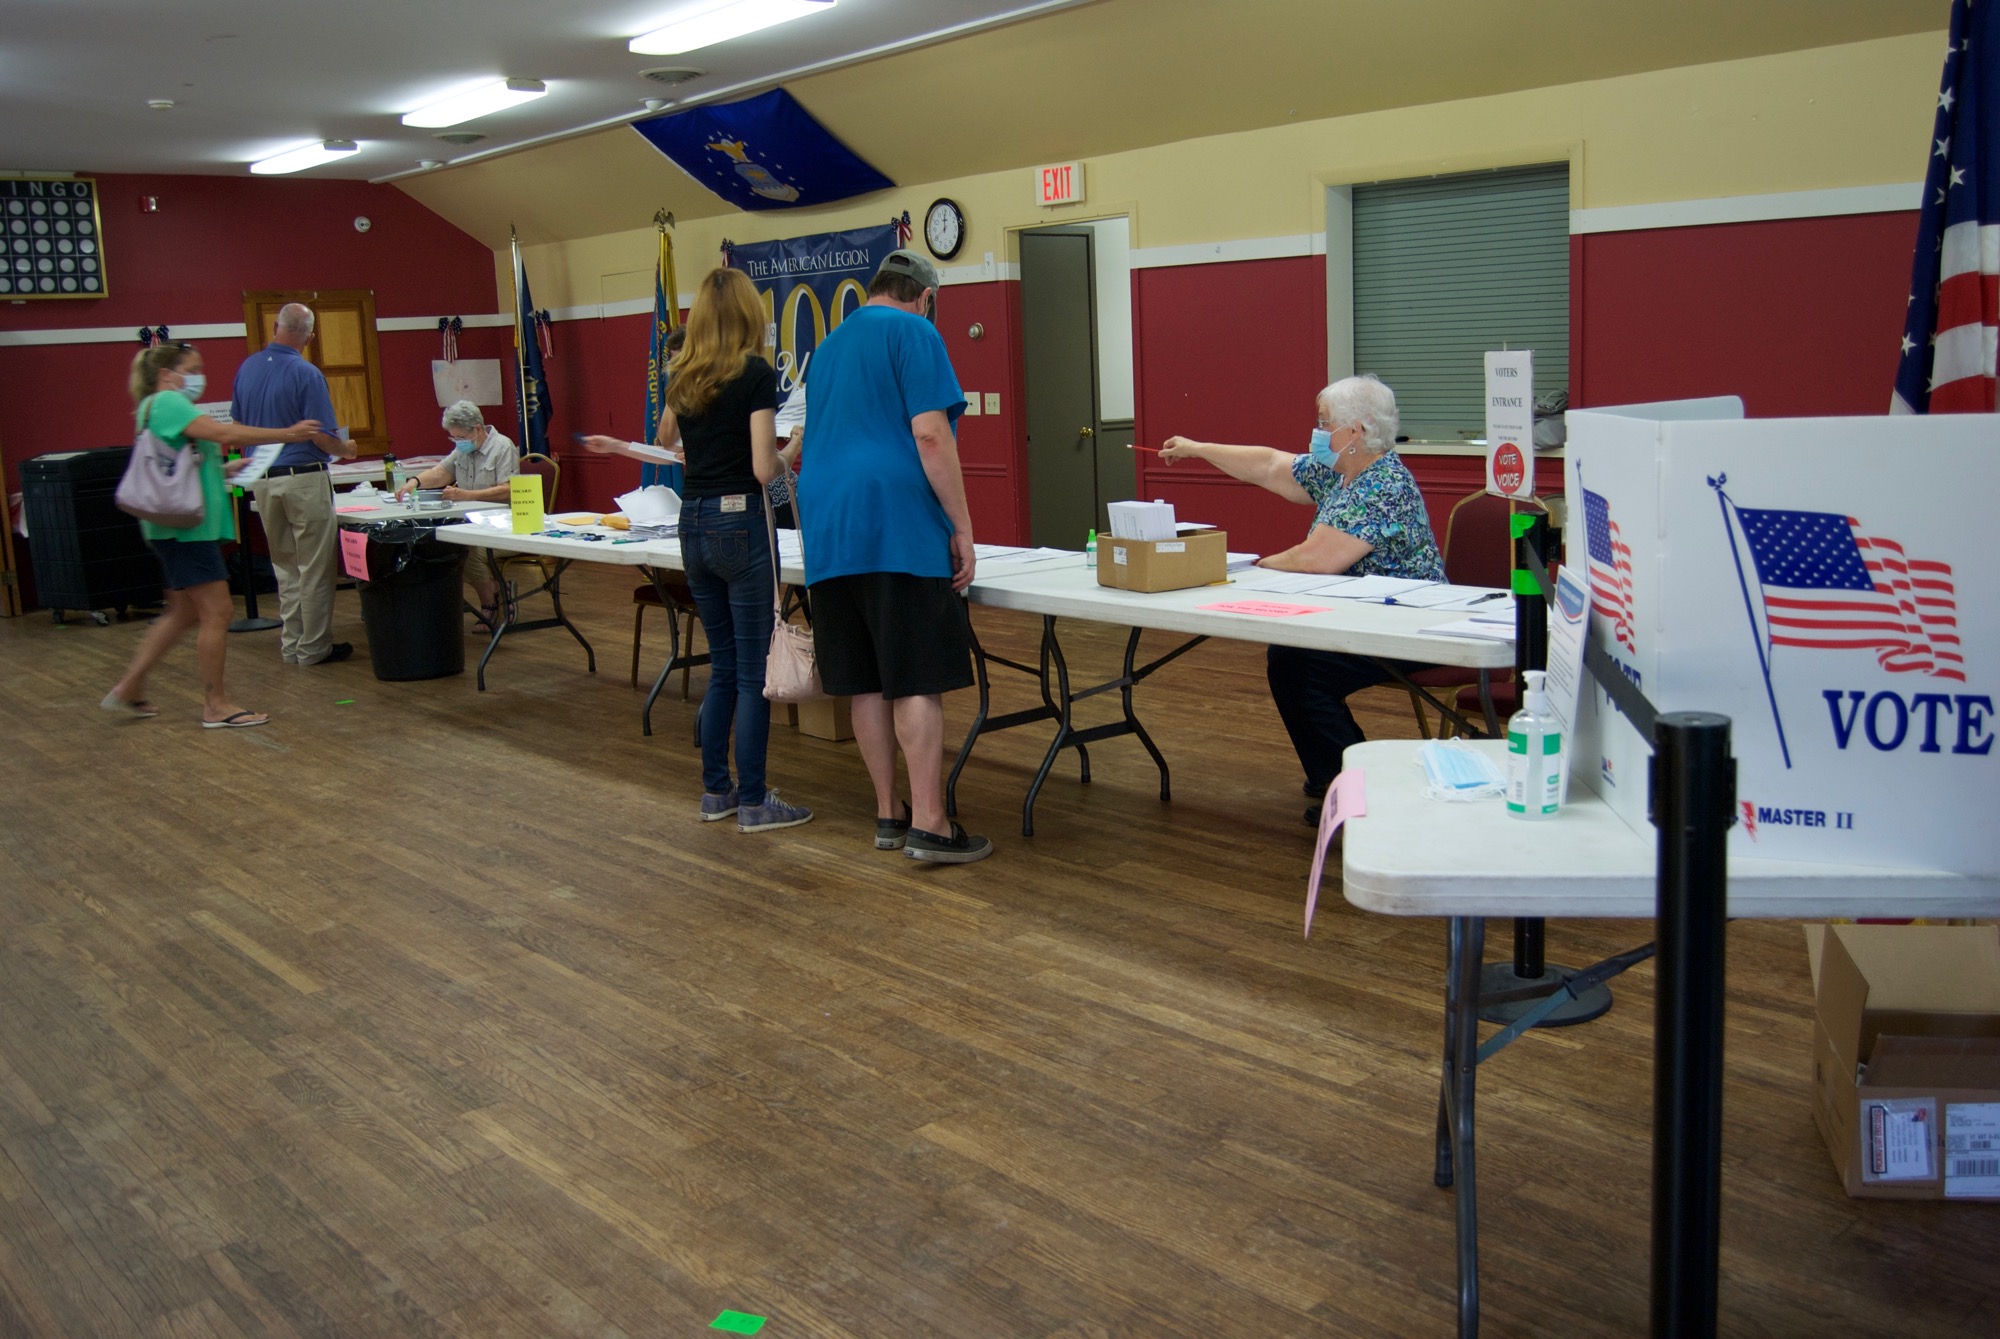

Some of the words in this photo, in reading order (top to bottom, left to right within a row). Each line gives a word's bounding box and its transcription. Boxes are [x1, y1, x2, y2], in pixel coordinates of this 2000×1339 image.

[1043, 166, 1072, 201] EXIT
[747, 260, 768, 277] THE
[771, 254, 828, 275] AMERICAN
[829, 249, 870, 268] LEGION
[1494, 367, 1518, 378] VOTERS
[1492, 396, 1523, 408] ENTRANCE
[1498, 453, 1517, 465] VOTE
[1497, 472, 1520, 487] VOICE
[1822, 689, 1995, 756] VOTE
[1757, 806, 1826, 828] MASTER
